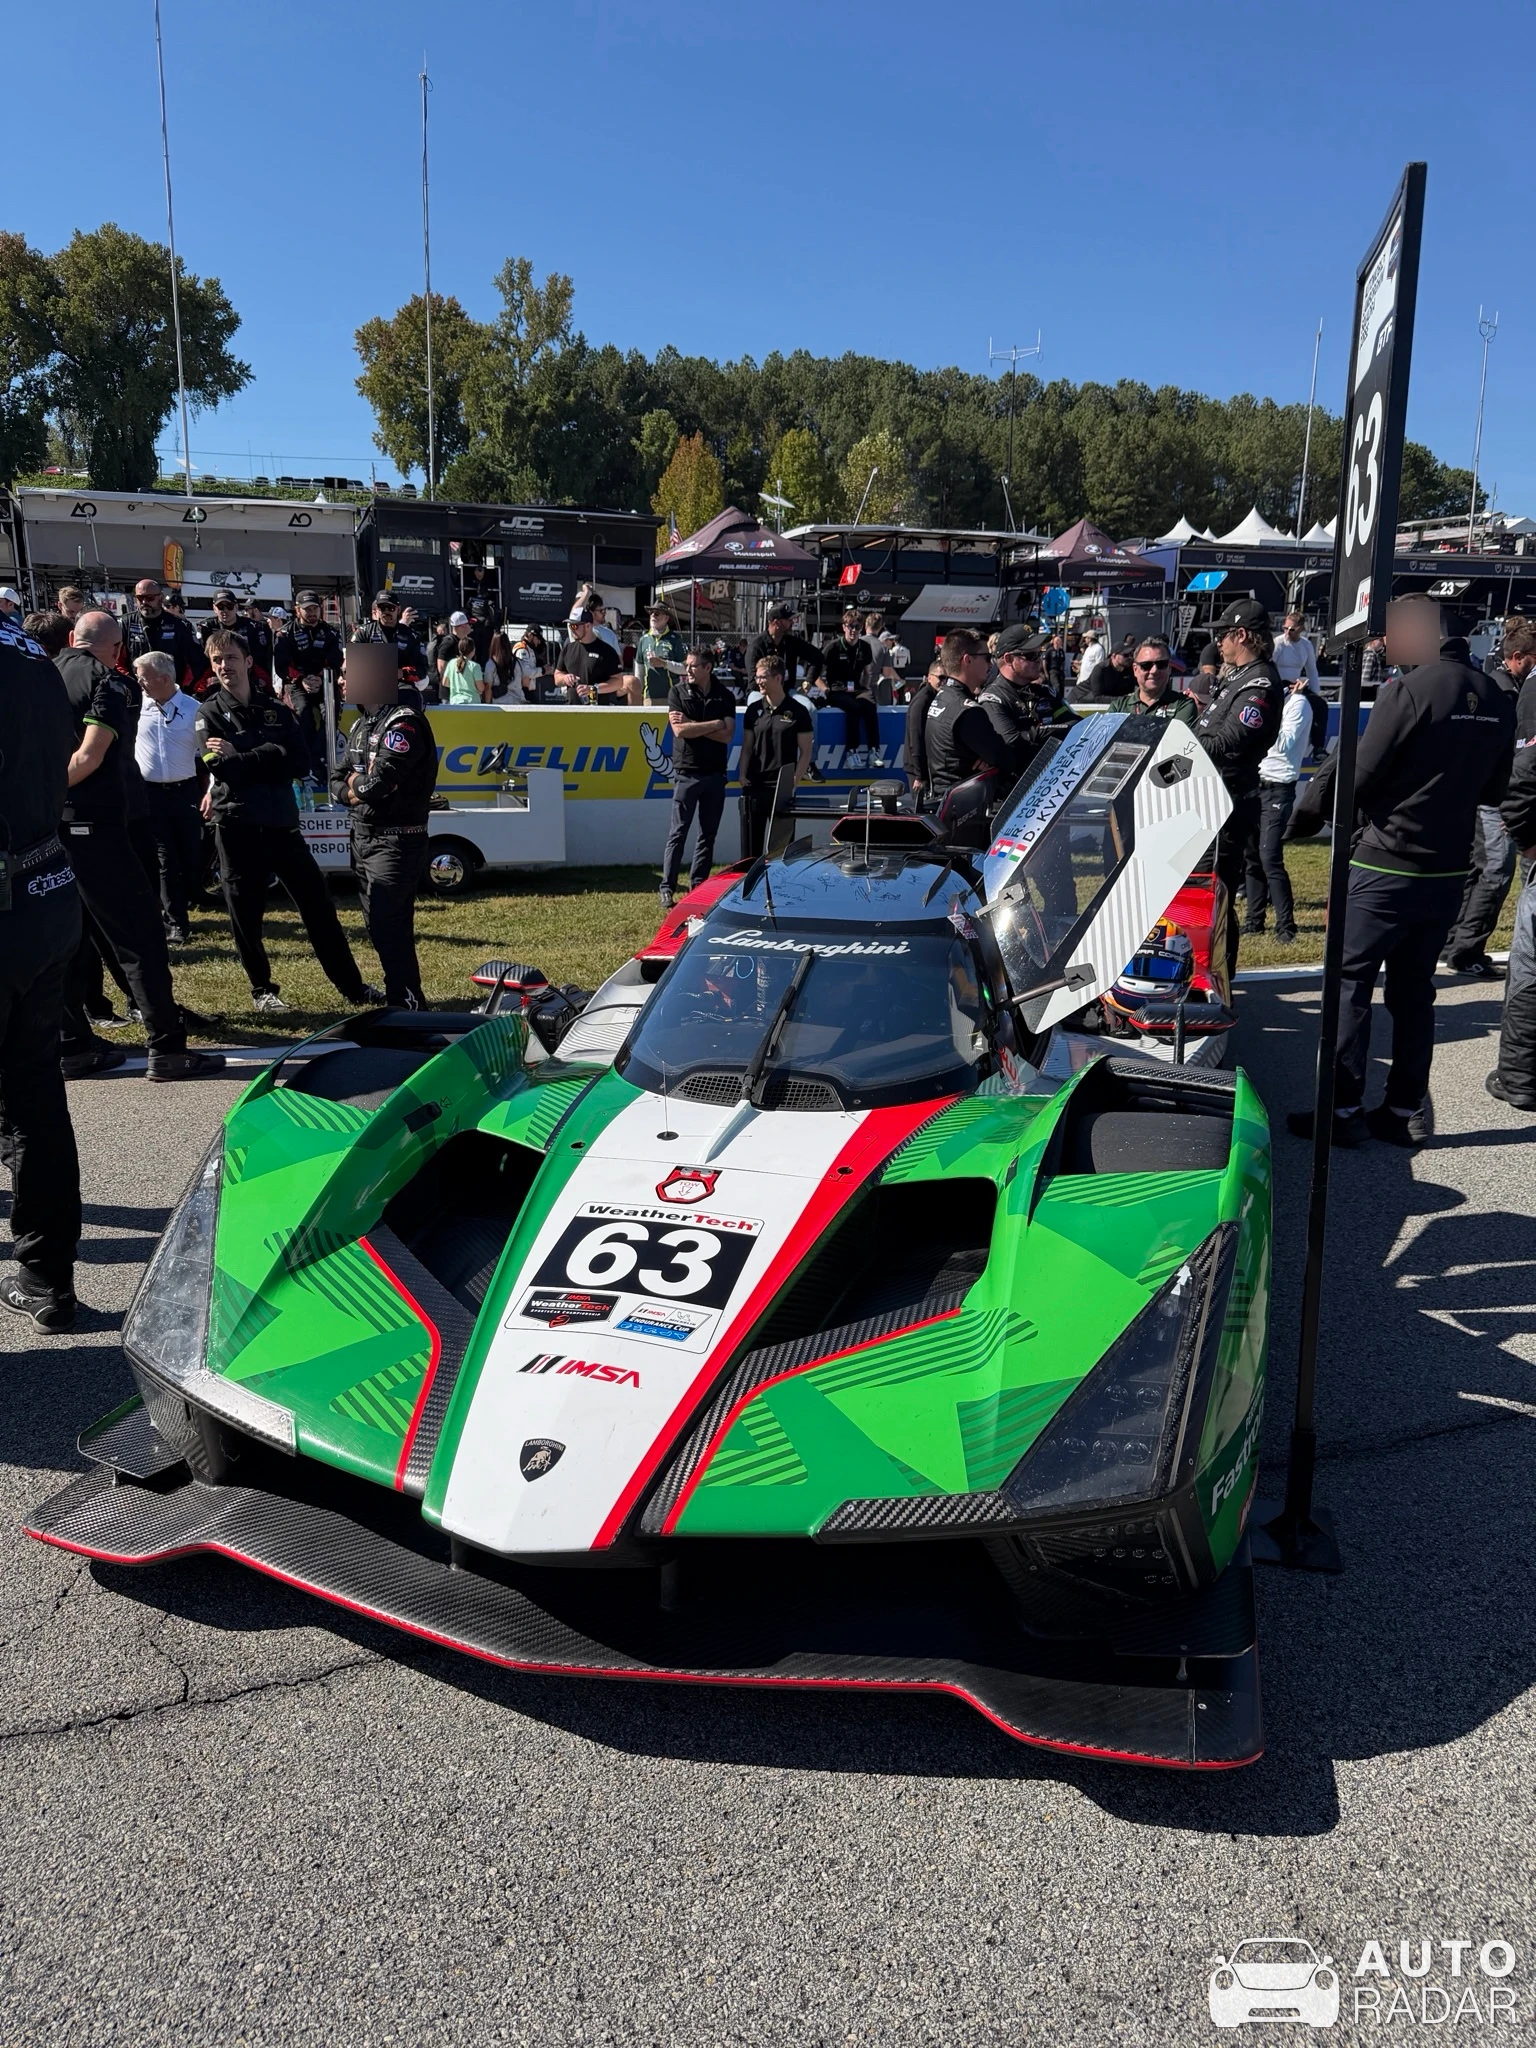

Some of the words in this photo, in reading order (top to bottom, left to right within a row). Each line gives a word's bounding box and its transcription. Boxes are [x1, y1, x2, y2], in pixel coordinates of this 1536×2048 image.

[1345, 391, 1383, 558] 63
[500, 516, 544, 530] JDC
[1095, 556, 1131, 564] Motorsport
[1203, 574, 1209, 588] 1
[519, 583, 563, 595] JDC
[1440, 582, 1454, 595] 23
[939, 606, 980, 614] RACING
[1017, 744, 1076, 818] MORTARA
[1025, 737, 1089, 819] GROSJEAN
[1022, 828, 1041, 842] D.
[1037, 768, 1080, 822] KVYAT
[707, 929, 911, 957] Lamborghini
[678, 1180, 701, 1189] TOW
[588, 1205, 754, 1231] WeatherTech
[566, 1221, 722, 1297] 63
[567, 1293, 591, 1301] IMSA
[531, 1300, 610, 1312] WeatherTech
[556, 1359, 643, 1389] IMSA
[524, 1438, 565, 1452] LAMBORGHINI
